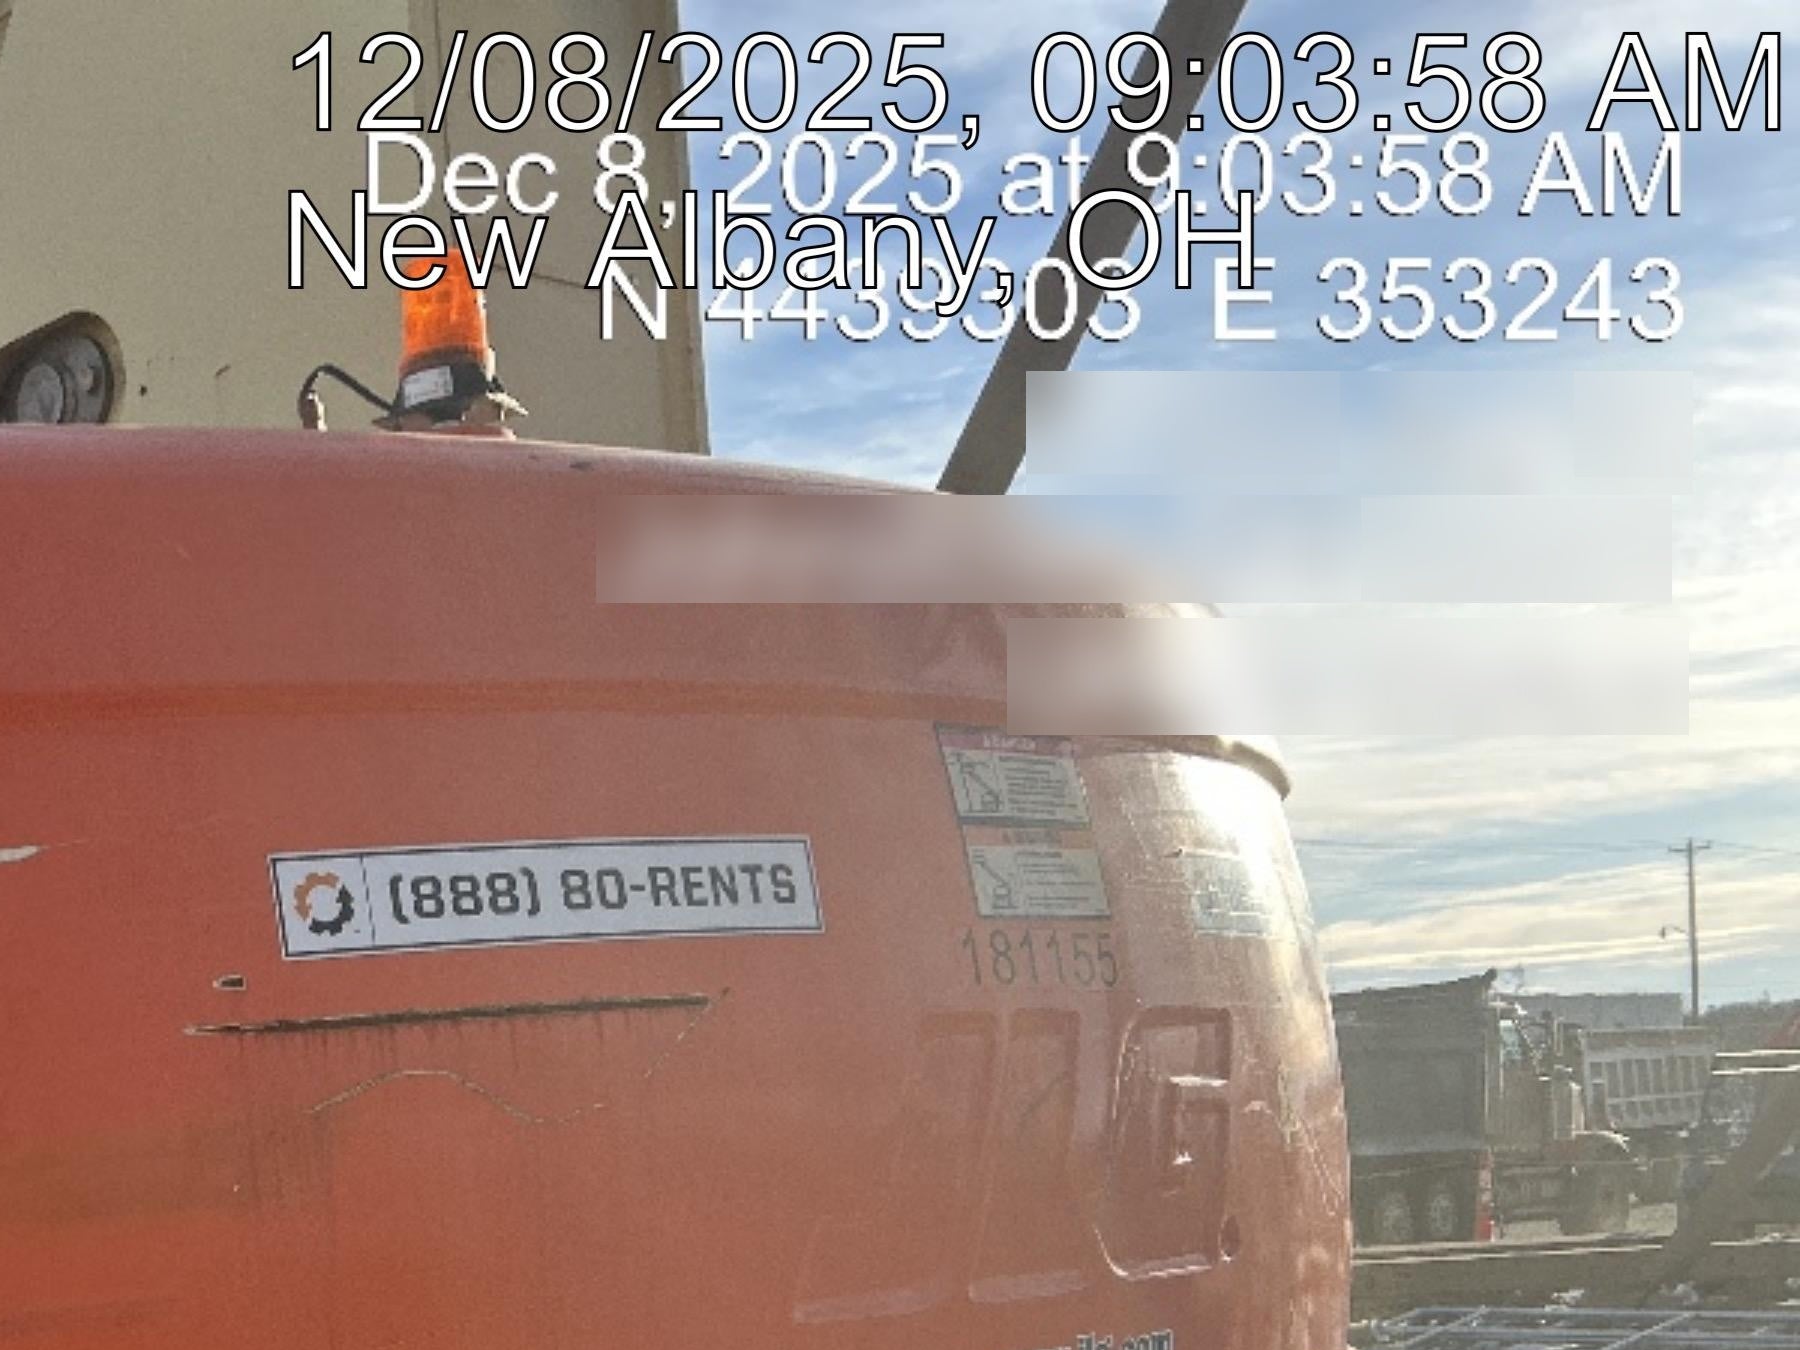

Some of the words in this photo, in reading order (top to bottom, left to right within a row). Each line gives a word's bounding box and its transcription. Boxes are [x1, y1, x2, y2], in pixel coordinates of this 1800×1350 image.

[388, 866, 541, 925] (888)
[560, 863, 797, 911] 80-RENTS
[961, 927, 1118, 987] 181155
